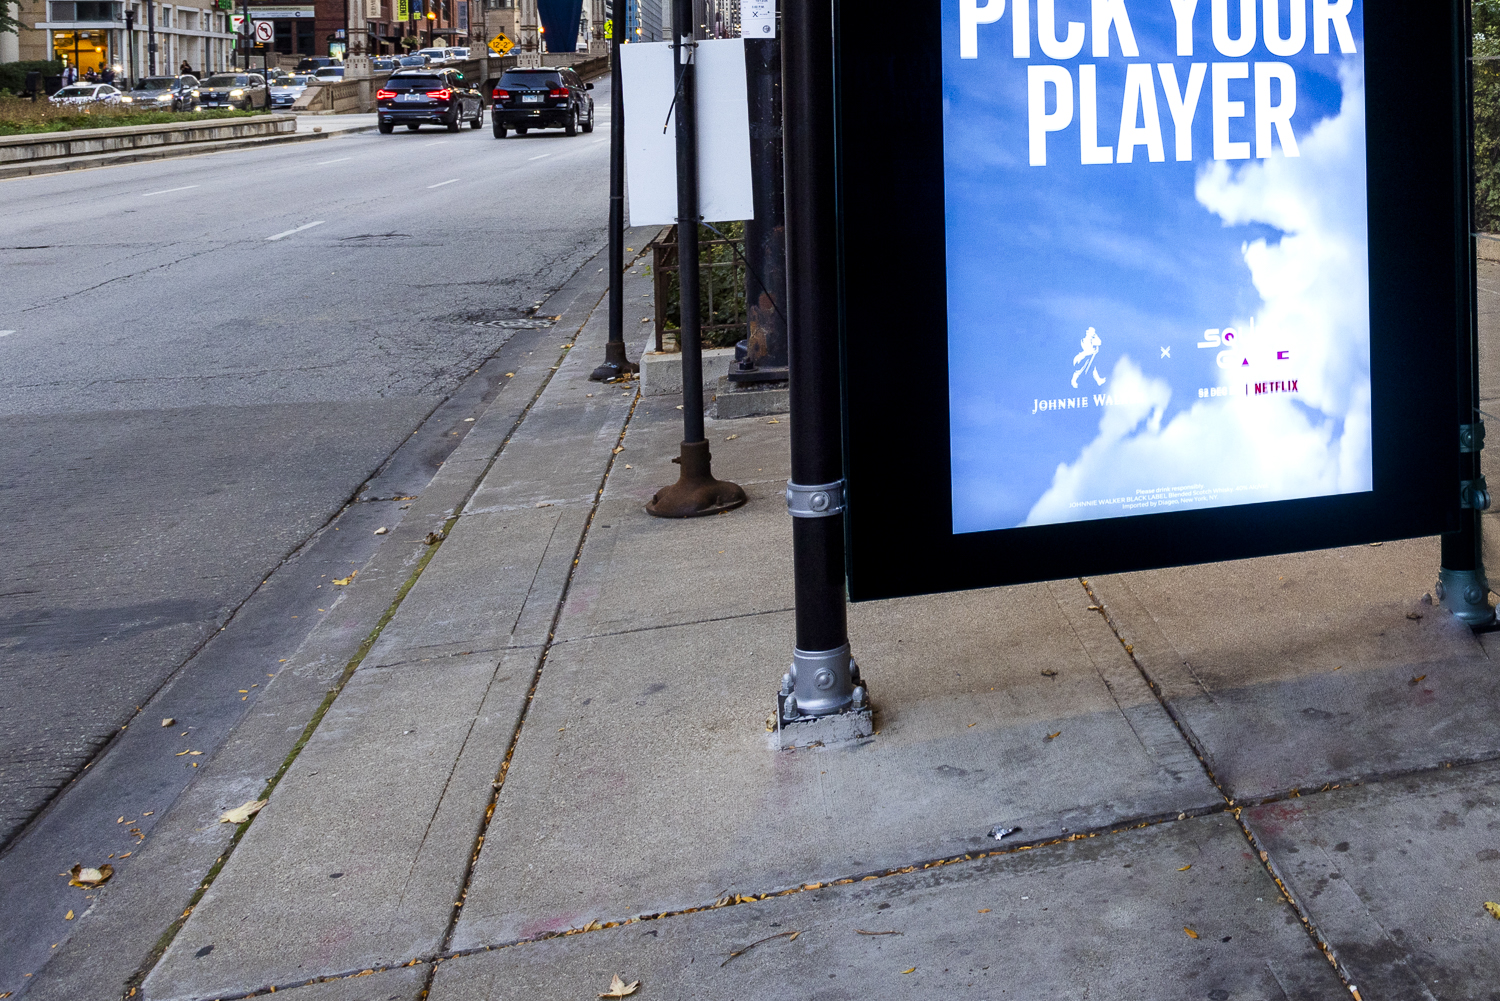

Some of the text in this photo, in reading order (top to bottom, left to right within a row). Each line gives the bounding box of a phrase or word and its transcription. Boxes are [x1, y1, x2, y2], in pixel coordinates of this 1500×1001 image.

[1027, 61, 1300, 166] PLAYER
[1254, 380, 1298, 396] NETFLIX
[1032, 396, 1088, 414] JOHNNIE
[1171, 484, 1204, 492] responsibly.
